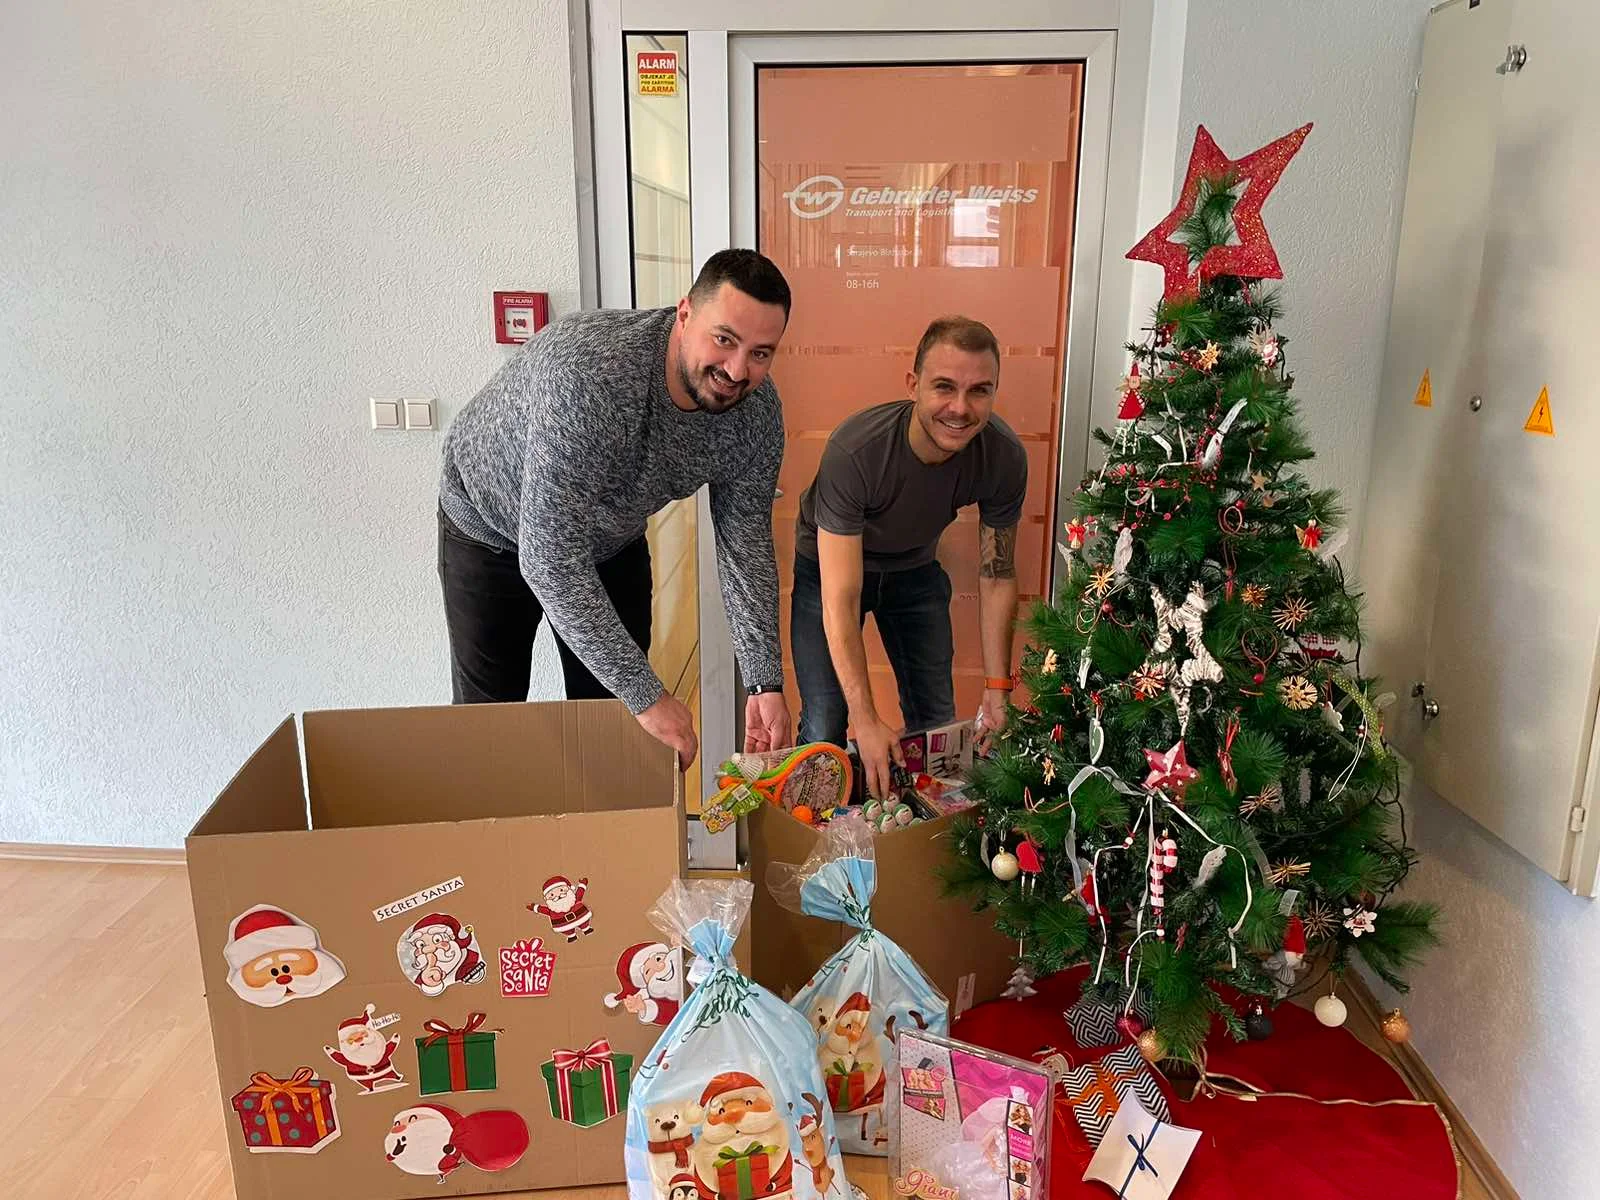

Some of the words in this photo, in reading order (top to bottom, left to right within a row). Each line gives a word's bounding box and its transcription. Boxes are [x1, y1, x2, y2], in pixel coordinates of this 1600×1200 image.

[639, 58, 675, 69] ALARM
[968, 184, 1039, 204] Weiss
[845, 207, 893, 218] Transport
[846, 279, 879, 289] 08-16h
[377, 896, 418, 919] SECRET
[421, 879, 463, 902] SANTA
